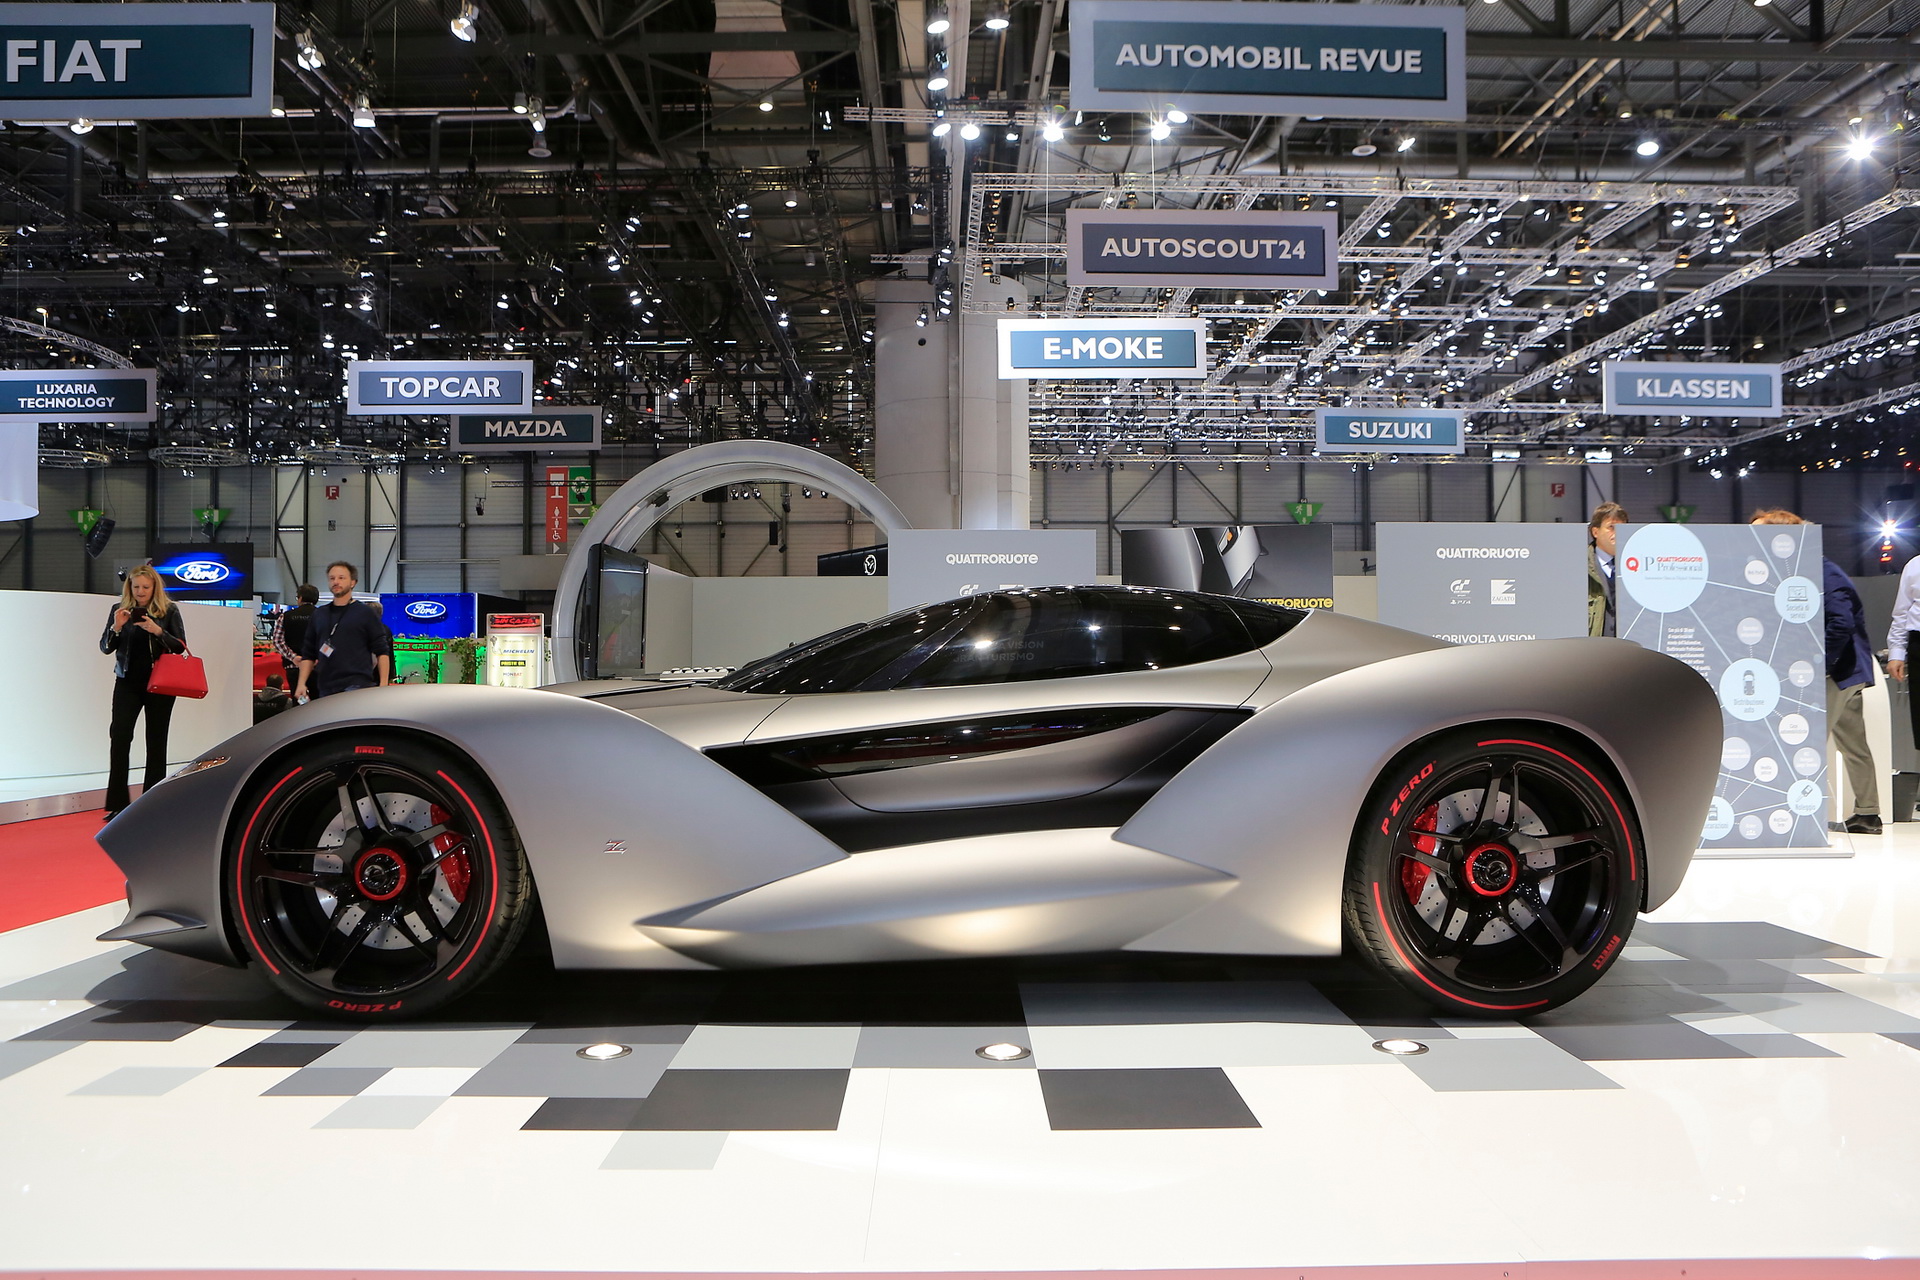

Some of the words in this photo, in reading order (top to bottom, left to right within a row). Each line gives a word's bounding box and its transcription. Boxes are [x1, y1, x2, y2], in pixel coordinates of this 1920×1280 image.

[6, 39, 142, 83] FIAT
[1115, 43, 1312, 72] AUTOMOBIL
[1319, 48, 1423, 74] REVUE
[1101, 237, 1306, 260] AUTOSCOUT24
[1043, 336, 1164, 361] E-MOKE
[36, 384, 98, 395] LUXARIA
[380, 377, 502, 398] TOPCAR
[1636, 378, 1751, 400] KLASSEN
[18, 397, 116, 409] TECHNOLOGY
[484, 420, 568, 438] MAZDA
[1348, 420, 1433, 440] SUZUKI
[183, 563, 221, 581] Ford
[412, 603, 438, 615] Ford
[1498, 634, 1536, 643] VISION
[354, 745, 385, 755] PIRELLI
[1380, 817, 1390, 836] P
[1389, 762, 1434, 817] ZERO
[1591, 934, 1621, 971] PIRELLI
[327, 999, 386, 1013] ZERO
[388, 1000, 403, 1011] P
